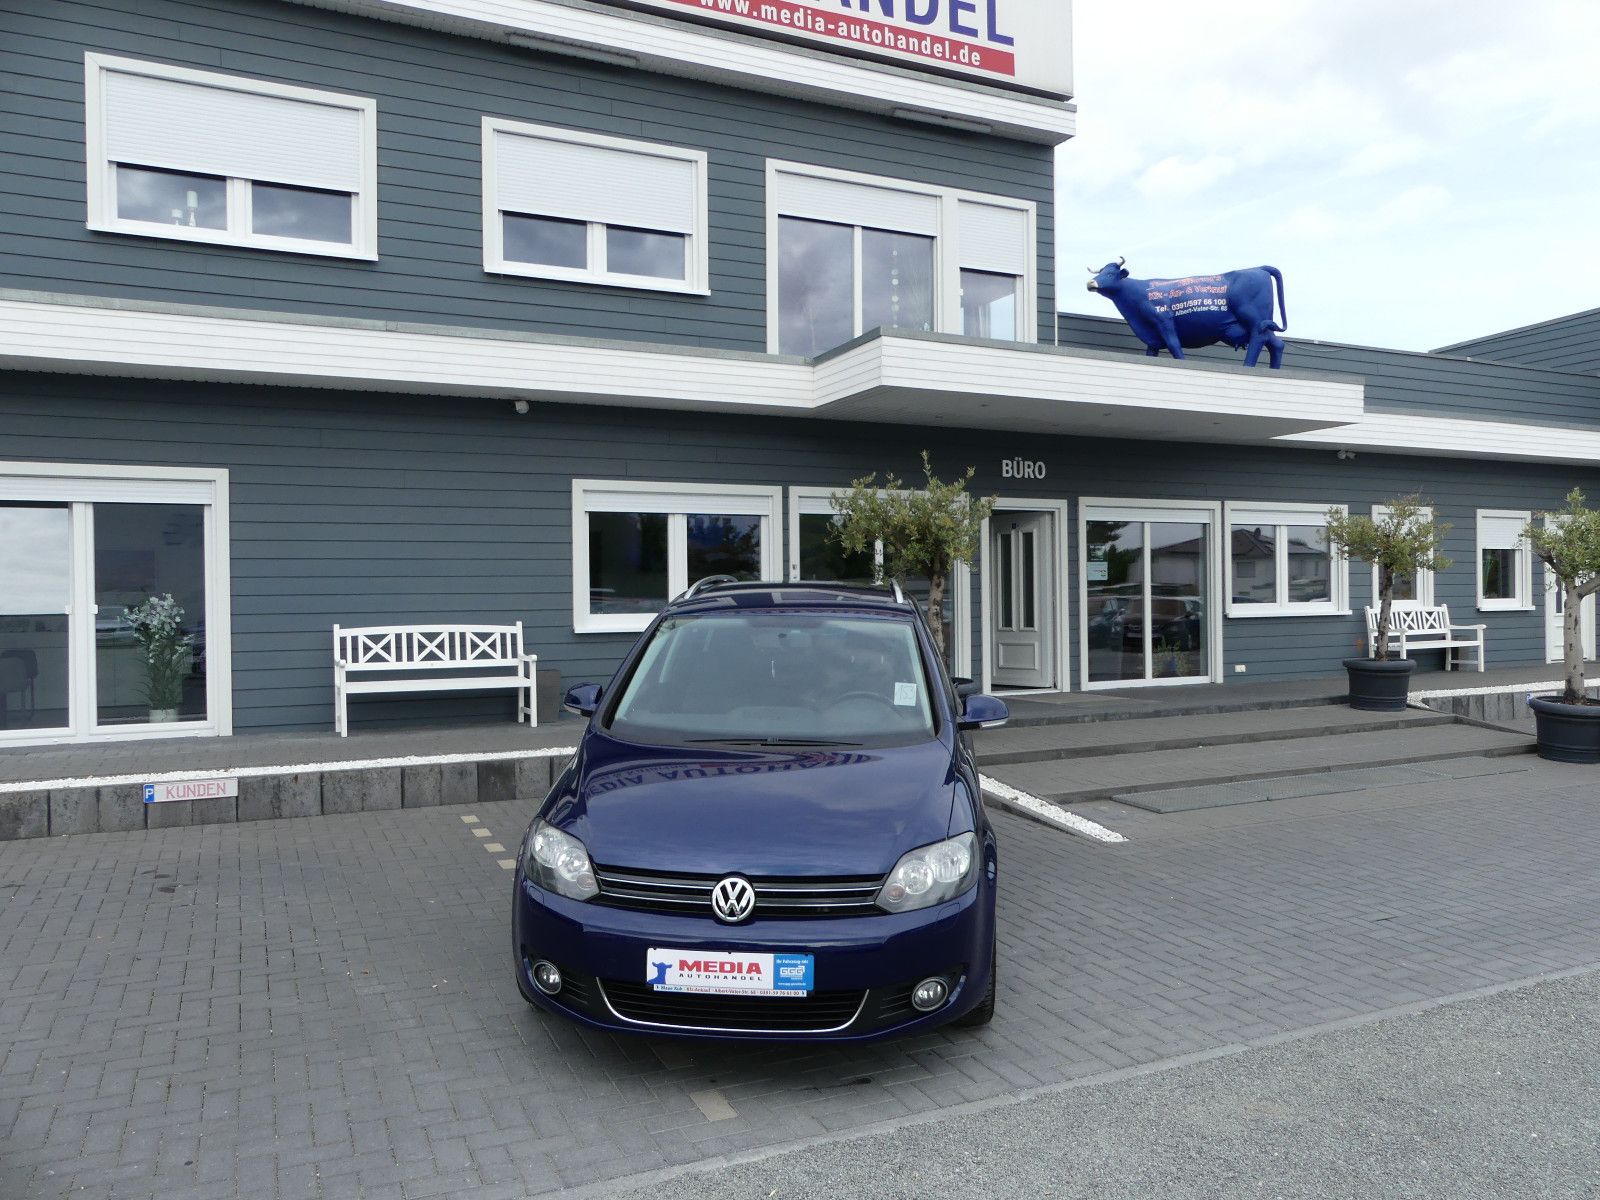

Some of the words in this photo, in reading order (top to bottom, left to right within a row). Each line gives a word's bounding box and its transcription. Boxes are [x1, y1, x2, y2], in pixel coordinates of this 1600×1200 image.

[1002, 457, 1046, 479] BÜRO
[146, 788, 153, 799] P
[166, 782, 226, 799] KUNDEN
[713, 877, 755, 922] VW
[678, 960, 762, 974] MEDIA
